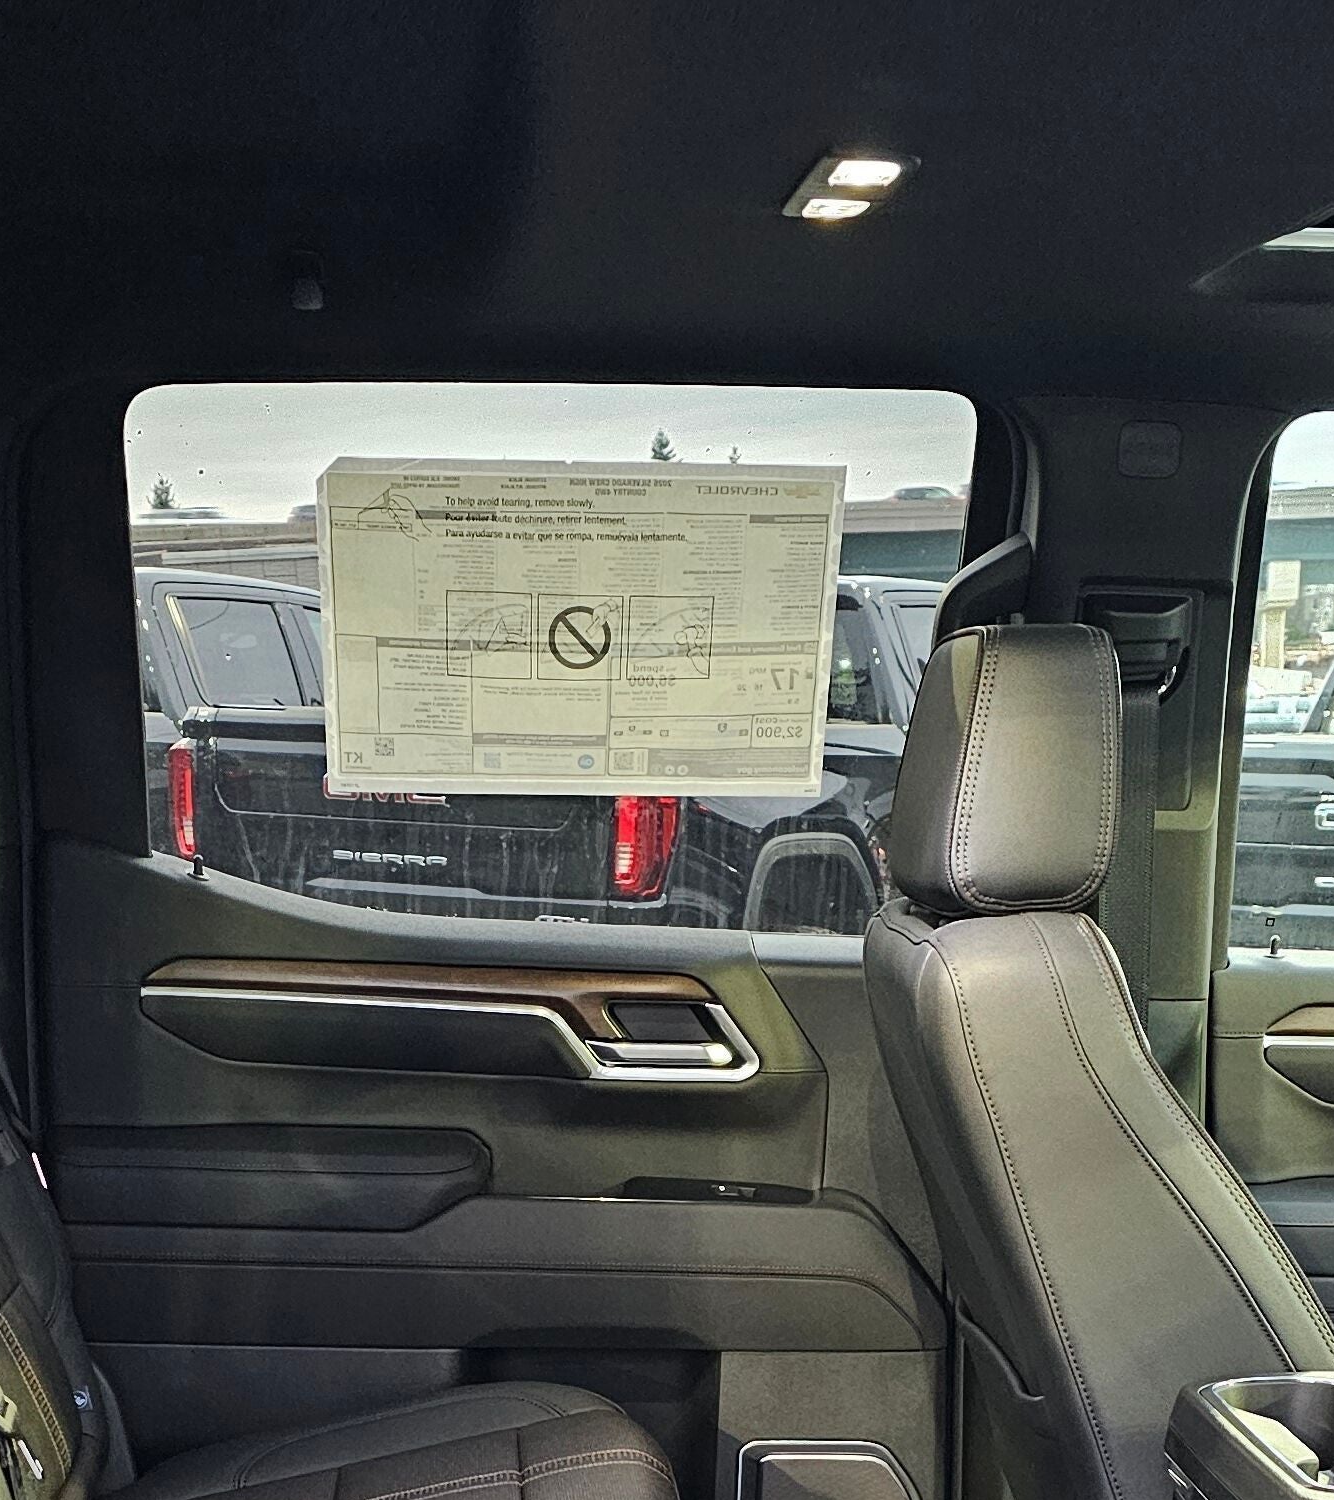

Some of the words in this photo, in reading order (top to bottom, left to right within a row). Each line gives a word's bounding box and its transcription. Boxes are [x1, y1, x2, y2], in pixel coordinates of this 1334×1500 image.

[445, 496, 455, 506] To
[457, 497, 475, 507] help
[477, 497, 499, 507] avoid
[501, 498, 533, 509] tearing,
[535, 499, 565, 507] remove
[567, 498, 595, 509] slowly.
[492, 514, 513, 523] toute
[557, 515, 582, 524] retirer
[445, 529, 464, 538] Para
[466, 530, 503, 541] ayudarse
[513, 531, 535, 540] evitar
[537, 533, 552, 542] que
[555, 532, 564, 540] se
[566, 533, 594, 543] rompa,
[640, 532, 687, 543] lentamente.
[332, 850, 448, 866] SIERRA
